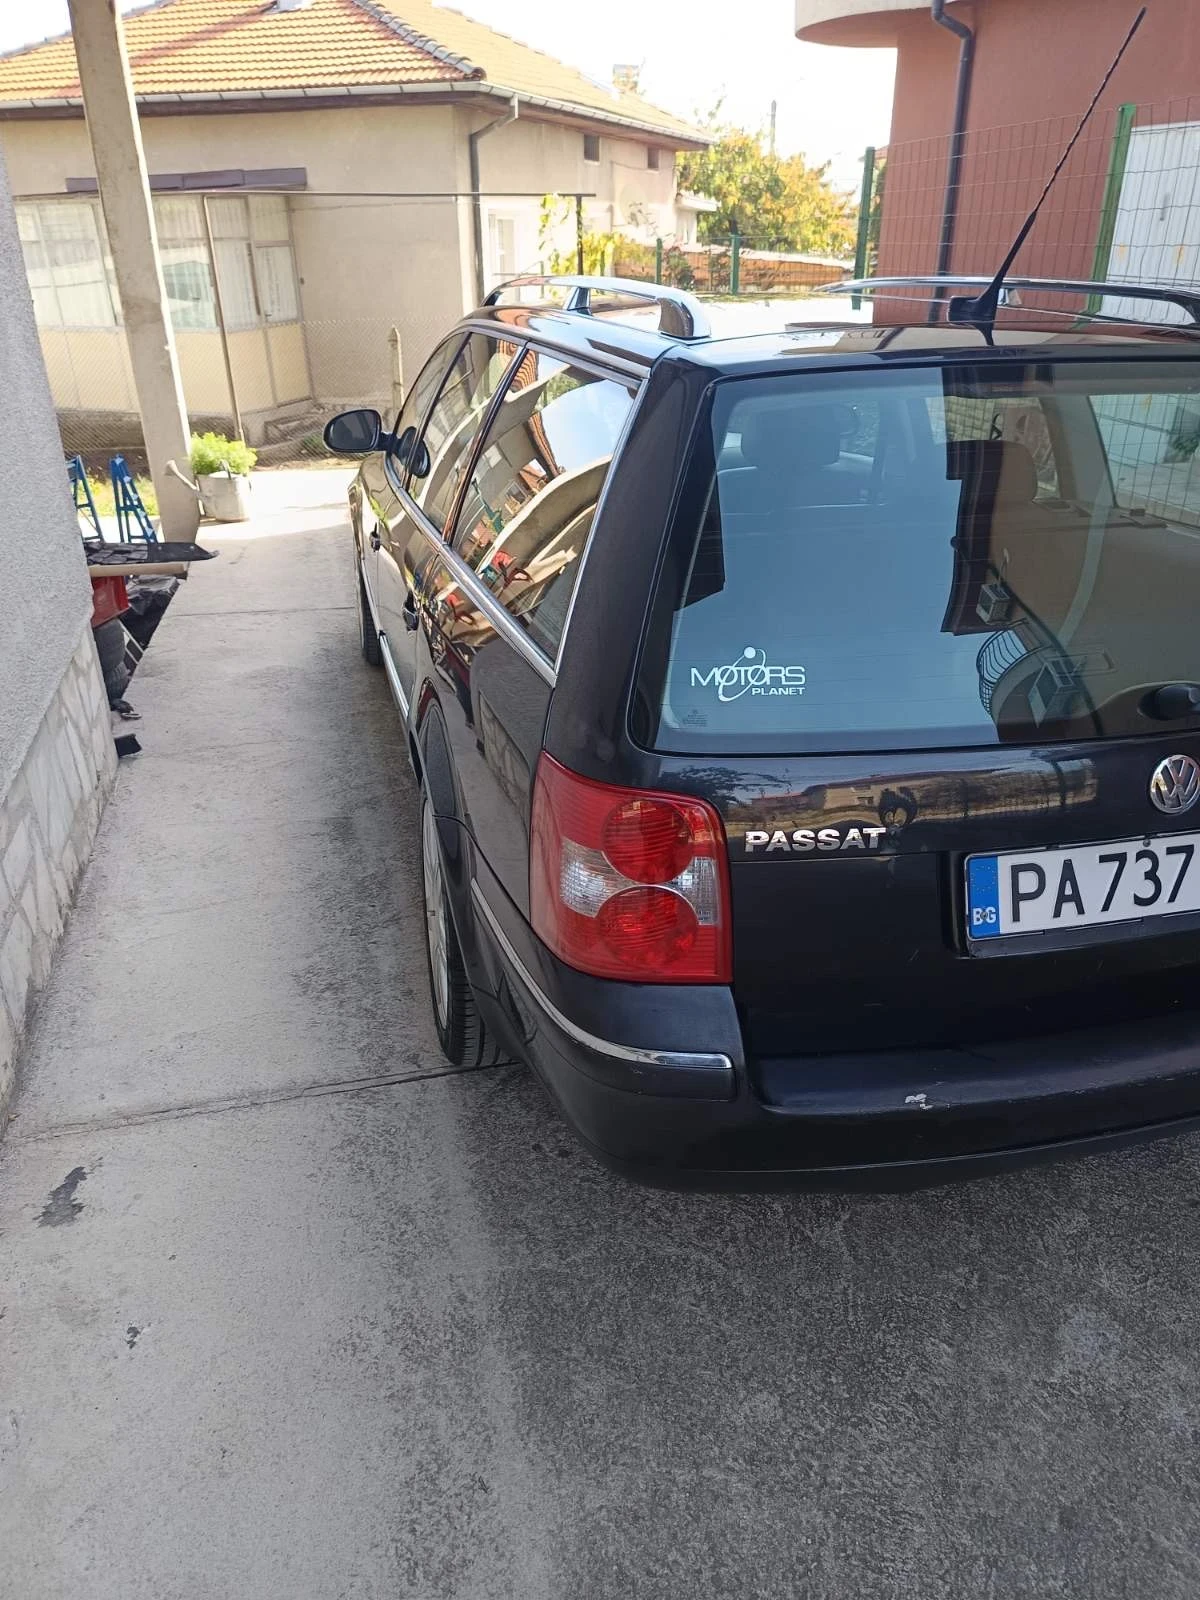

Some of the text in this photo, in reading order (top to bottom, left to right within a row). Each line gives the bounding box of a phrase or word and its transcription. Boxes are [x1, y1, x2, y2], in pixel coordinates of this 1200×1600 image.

[691, 664, 806, 686] MOTORS
[751, 687, 805, 696] PLANET
[745, 827, 886, 852] PASSAT
[972, 907, 997, 926] BG
